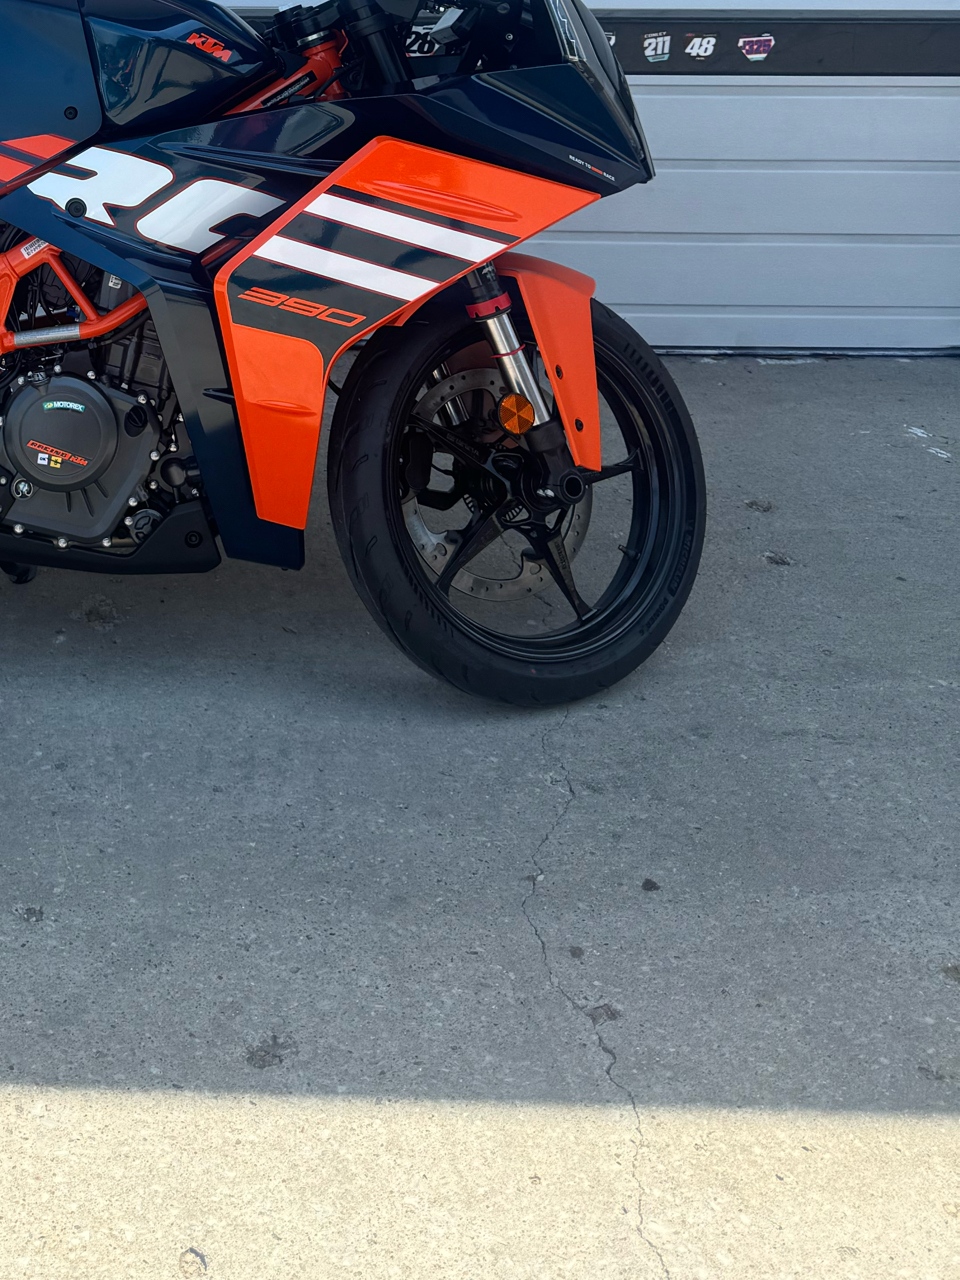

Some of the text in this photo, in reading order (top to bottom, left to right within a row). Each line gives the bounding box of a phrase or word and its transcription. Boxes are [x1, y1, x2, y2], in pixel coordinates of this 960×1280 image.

[186, 32, 232, 62] KTM
[643, 35, 671, 57] 211
[684, 37, 717, 57] 48
[26, 145, 287, 254] RC
[238, 286, 367, 327] 390
[53, 401, 84, 412] MOTOREX
[29, 440, 69, 459] RACING
